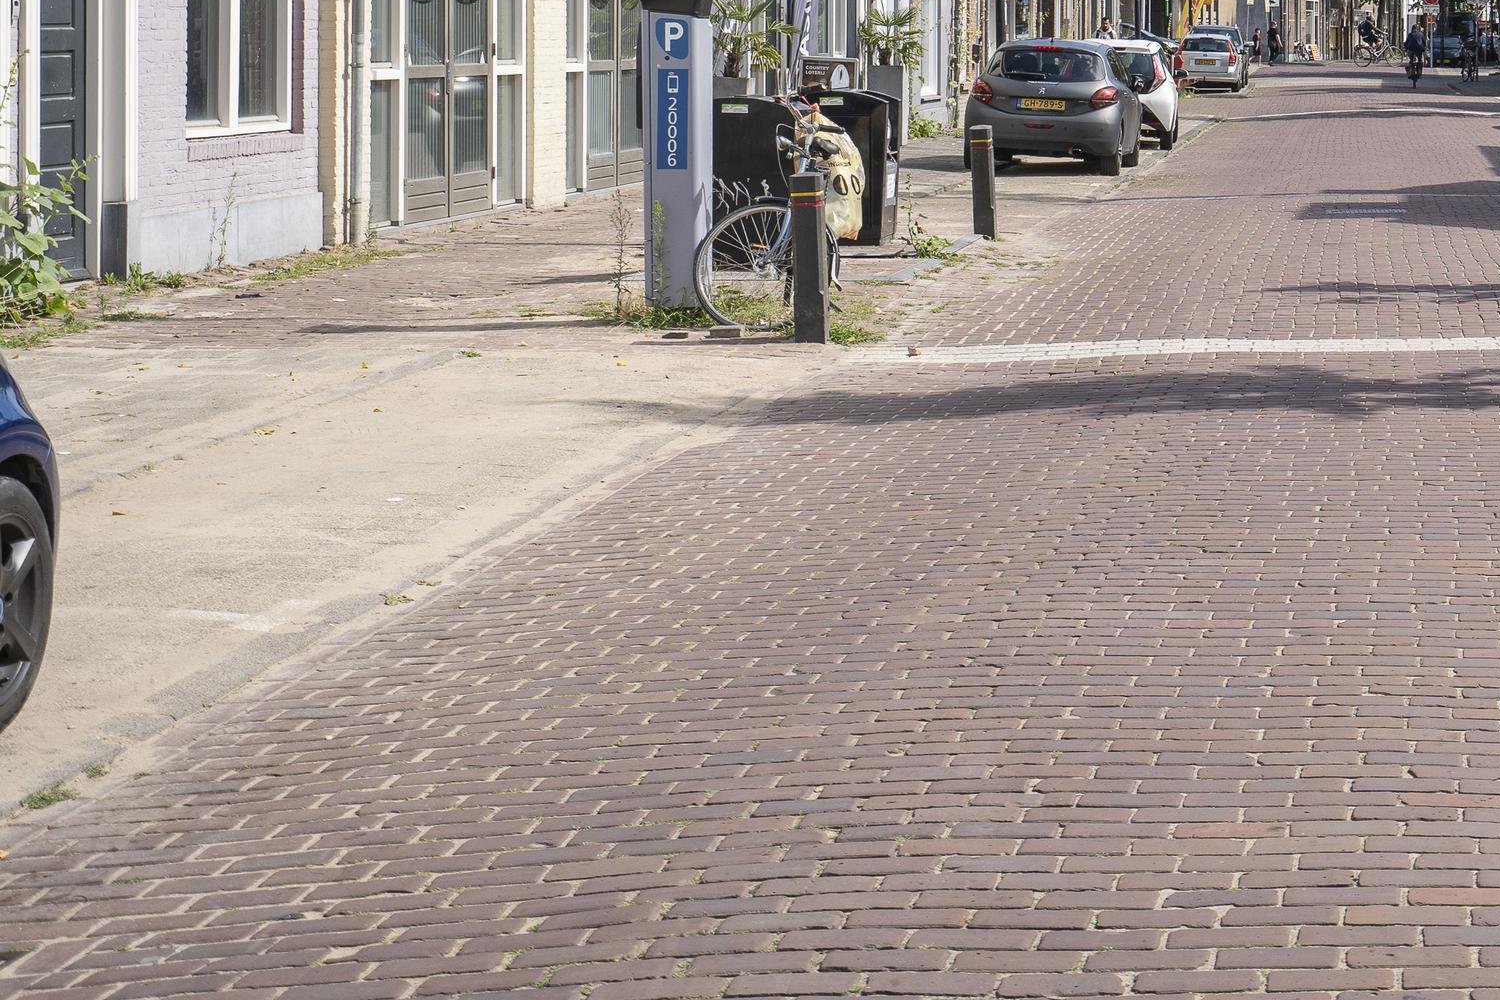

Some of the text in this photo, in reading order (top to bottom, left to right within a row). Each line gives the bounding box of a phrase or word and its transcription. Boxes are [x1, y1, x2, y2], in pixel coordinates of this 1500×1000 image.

[665, 22, 684, 52] P
[1024, 99, 1064, 109] GH-789-S
[667, 97, 678, 167] 20006
